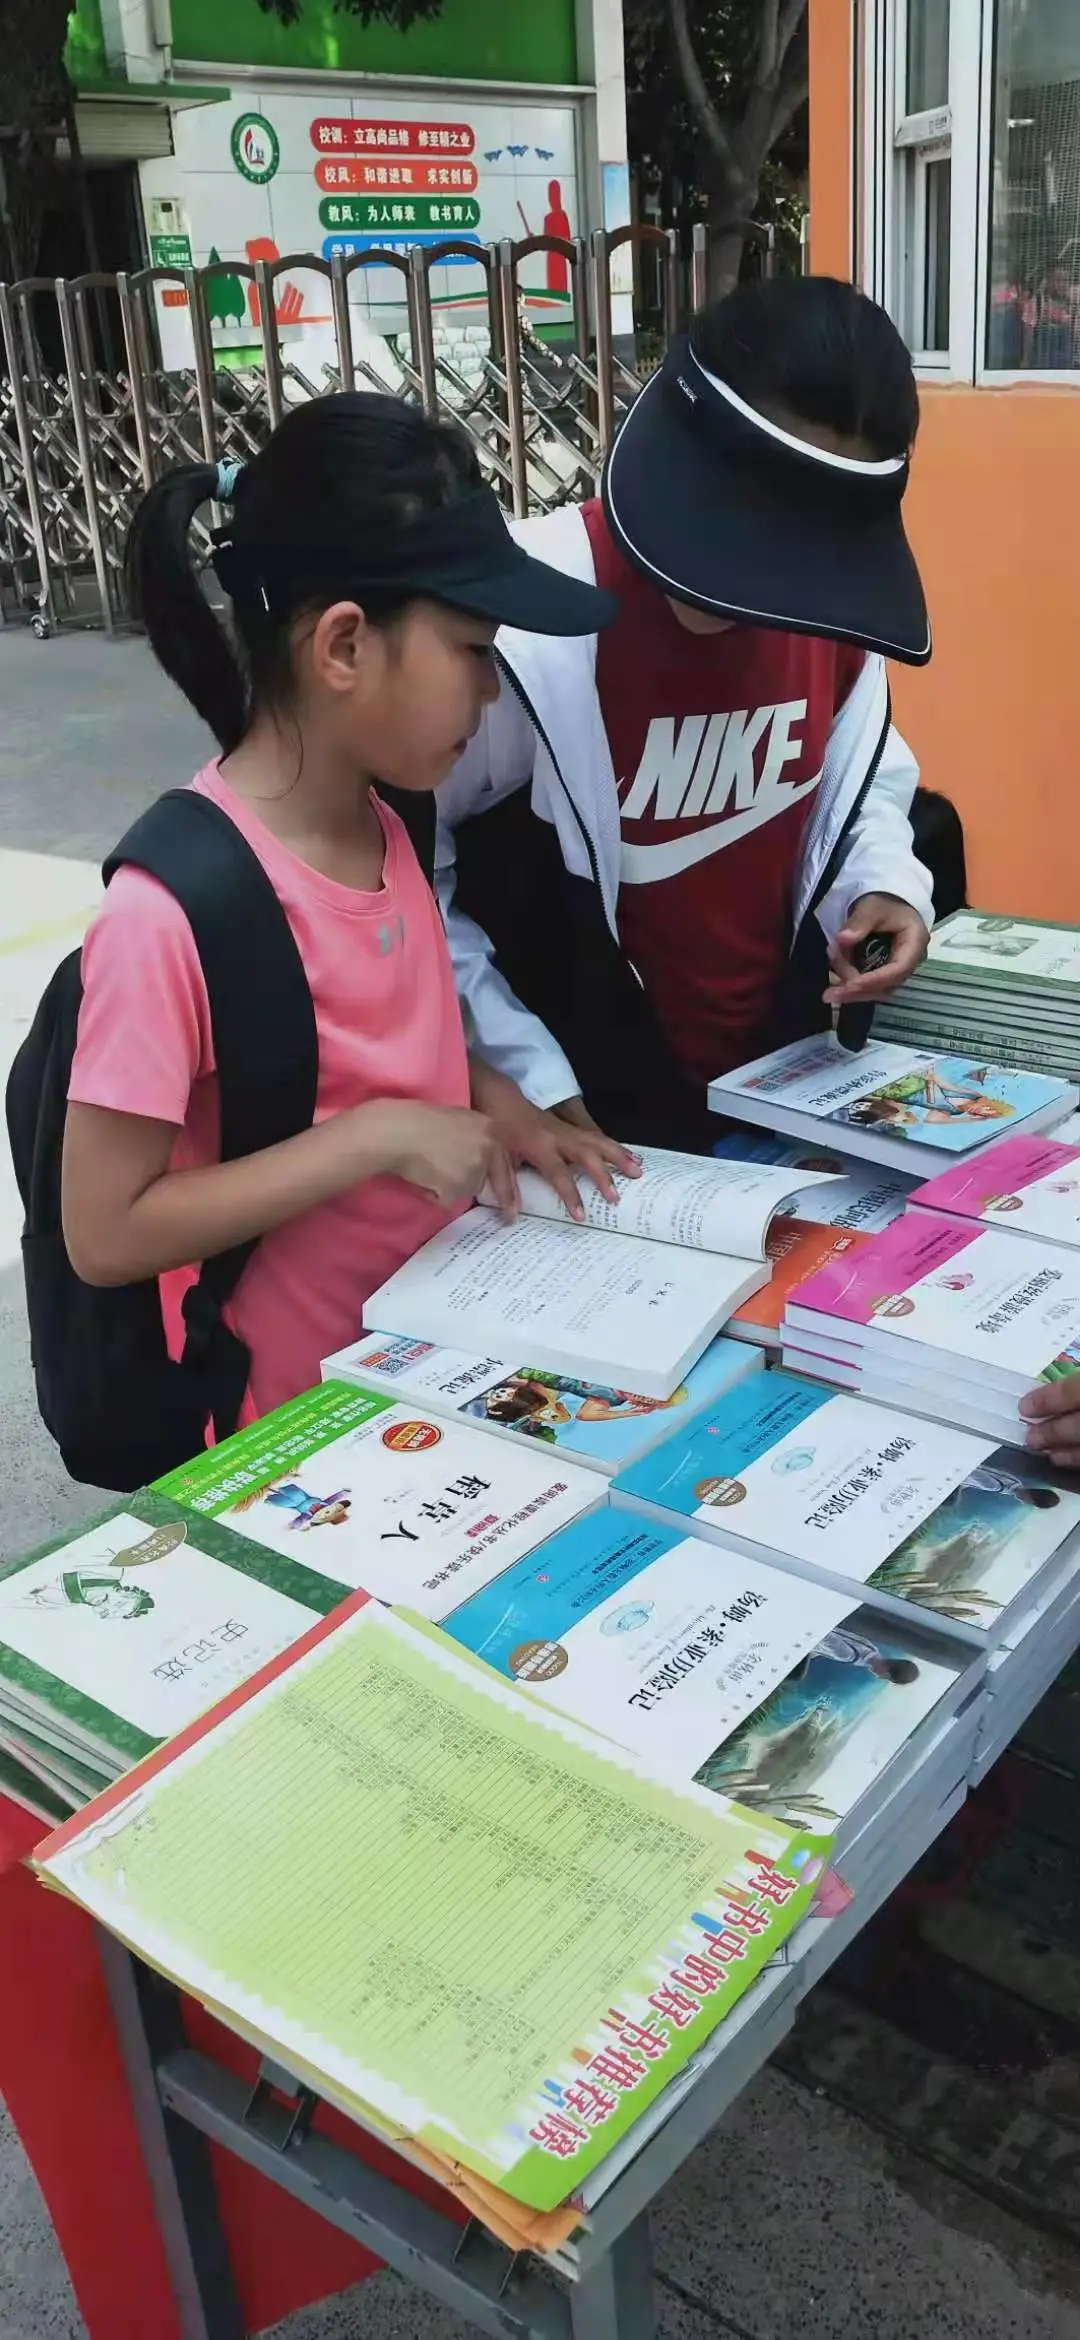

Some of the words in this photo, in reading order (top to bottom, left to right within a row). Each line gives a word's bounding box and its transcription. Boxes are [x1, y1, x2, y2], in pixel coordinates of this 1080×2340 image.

[427, 167, 473, 185] 求实创新
[429, 205, 475, 222] 教书育人
[620, 699, 807, 820] NIKE
[380, 1474, 493, 1541] 稻草人
[150, 1618, 249, 1682] 史记选
[628, 1589, 769, 1712] 汤姆·索亚历险记
[529, 1865, 799, 2159] 好书中的好书推荐榜
